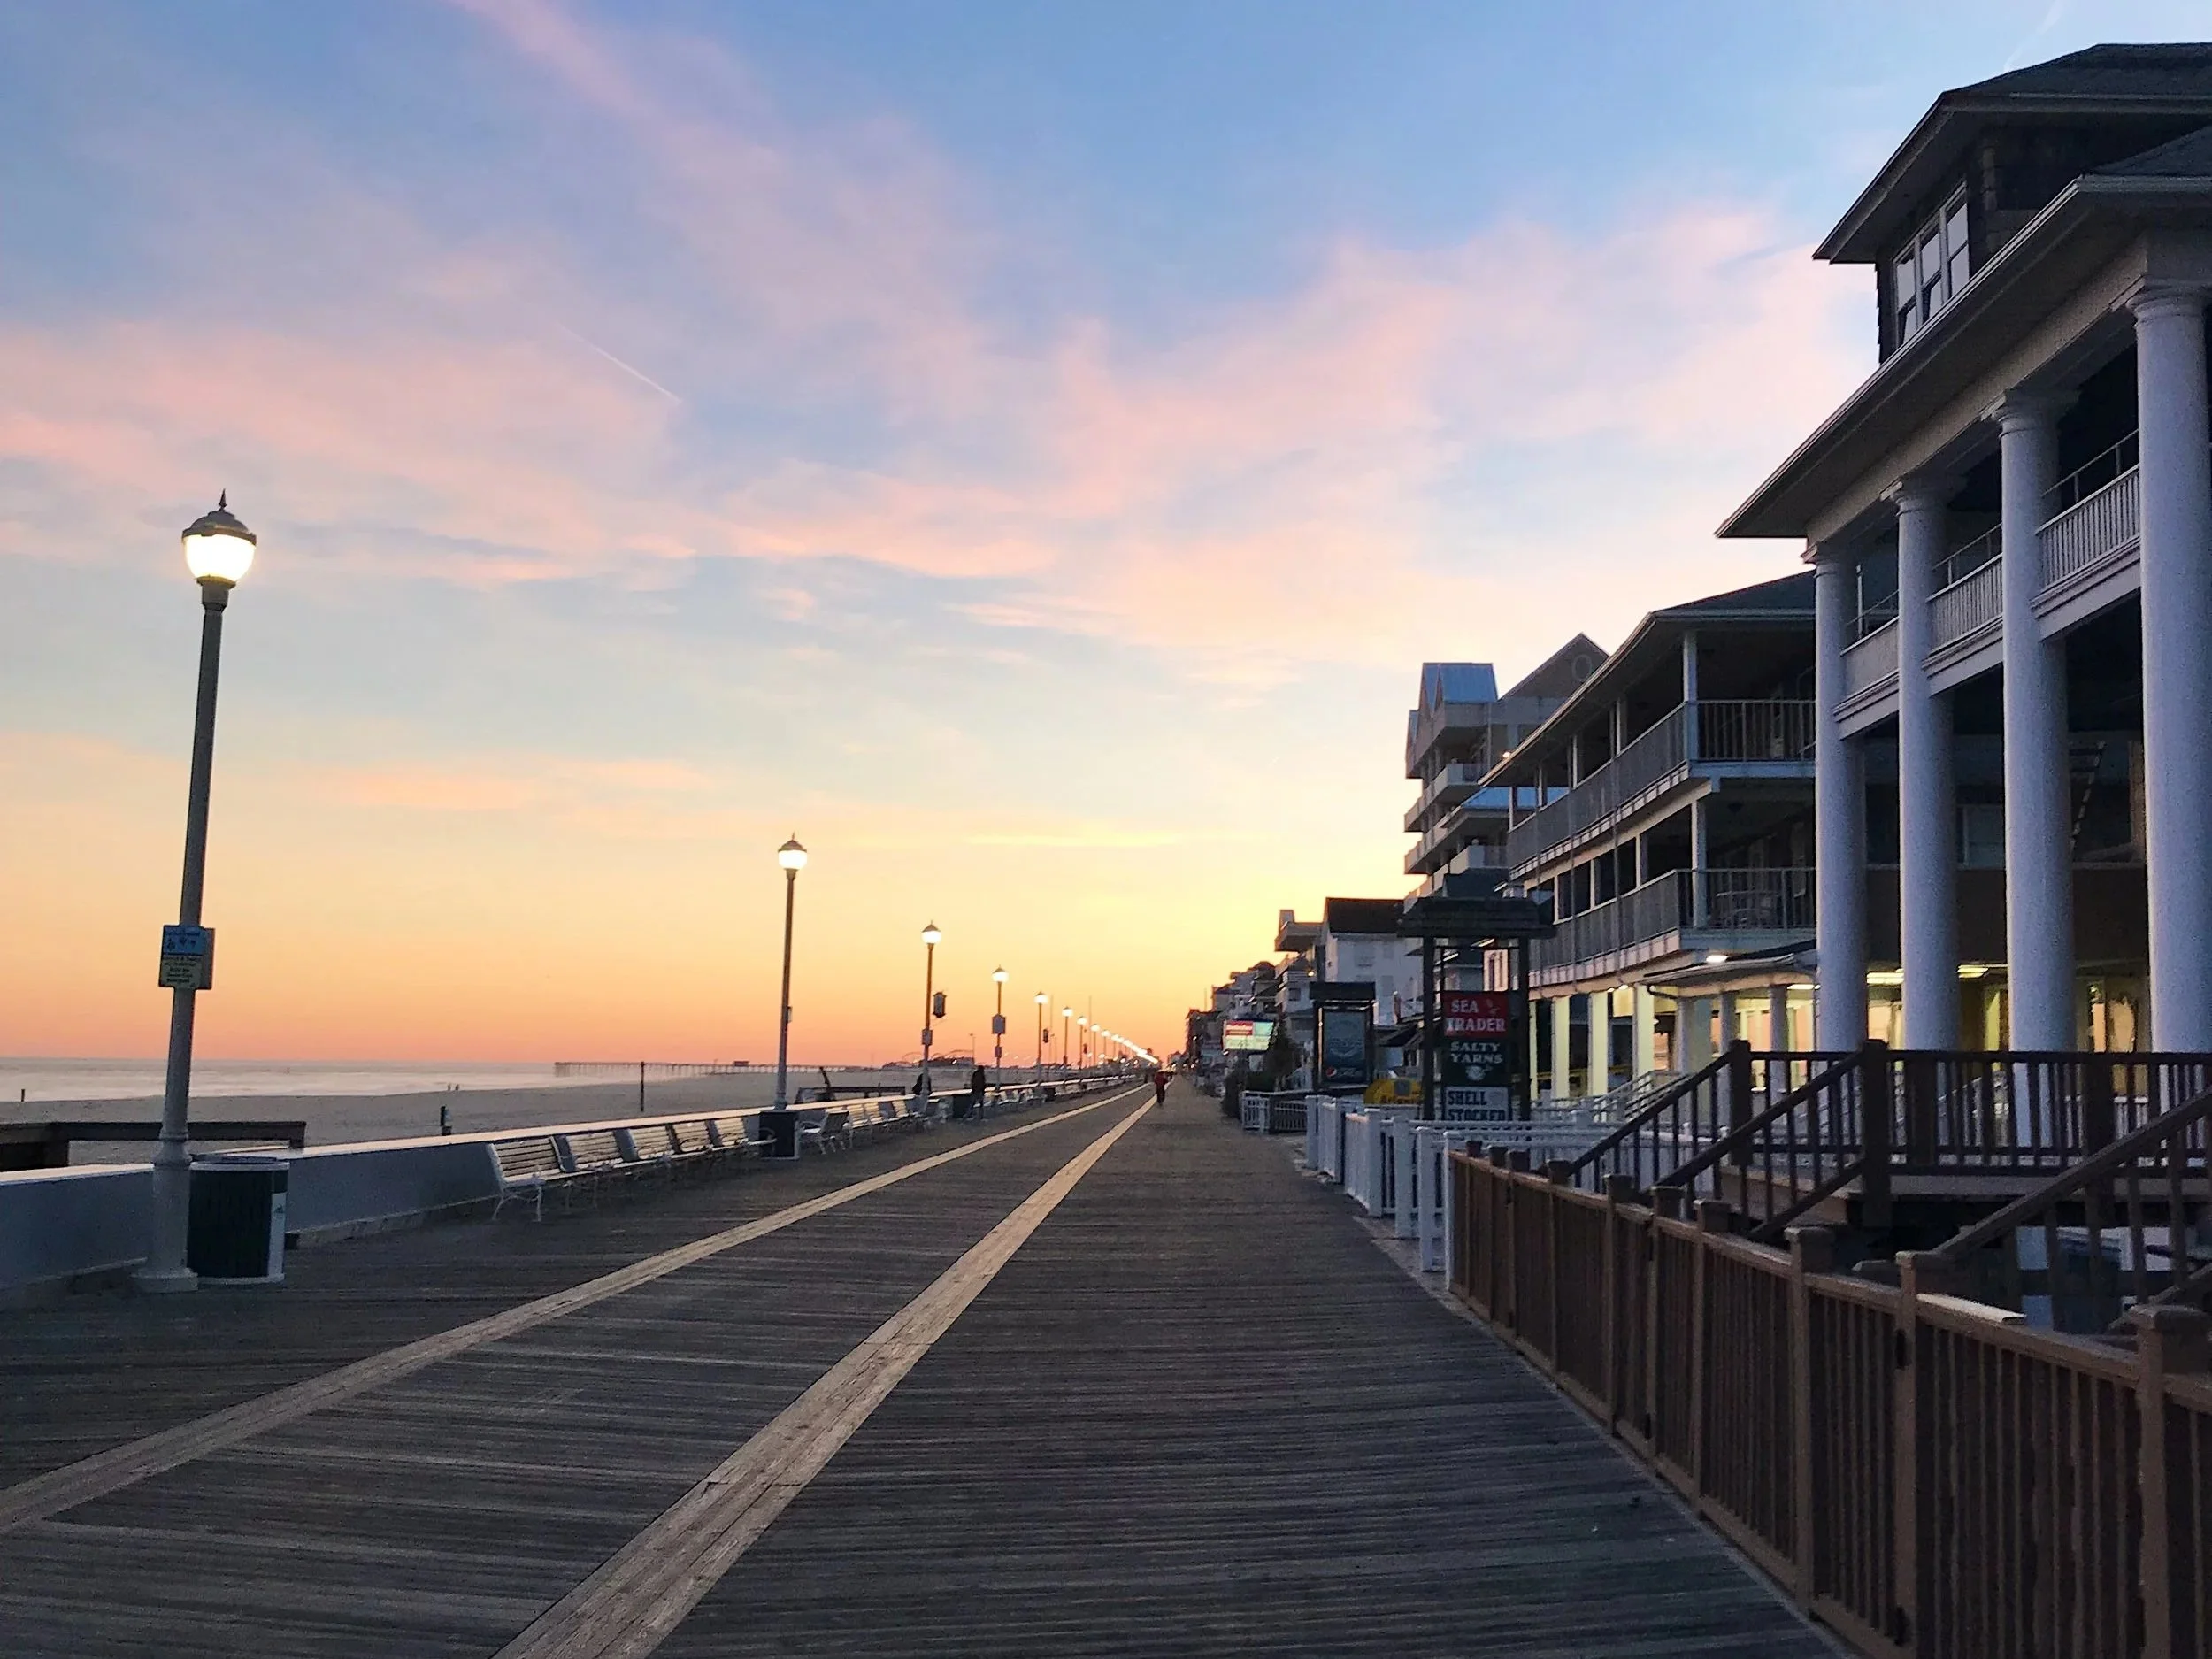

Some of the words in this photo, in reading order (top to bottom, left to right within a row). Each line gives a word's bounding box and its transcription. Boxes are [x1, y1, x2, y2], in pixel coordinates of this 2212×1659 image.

[1451, 999, 1479, 1013] SEA
[1445, 1018, 1506, 1032] TRADER
[1451, 1041, 1500, 1052] SALTY
[1451, 1053, 1503, 1064] YARNS
[1448, 1091, 1487, 1105] SHELL
